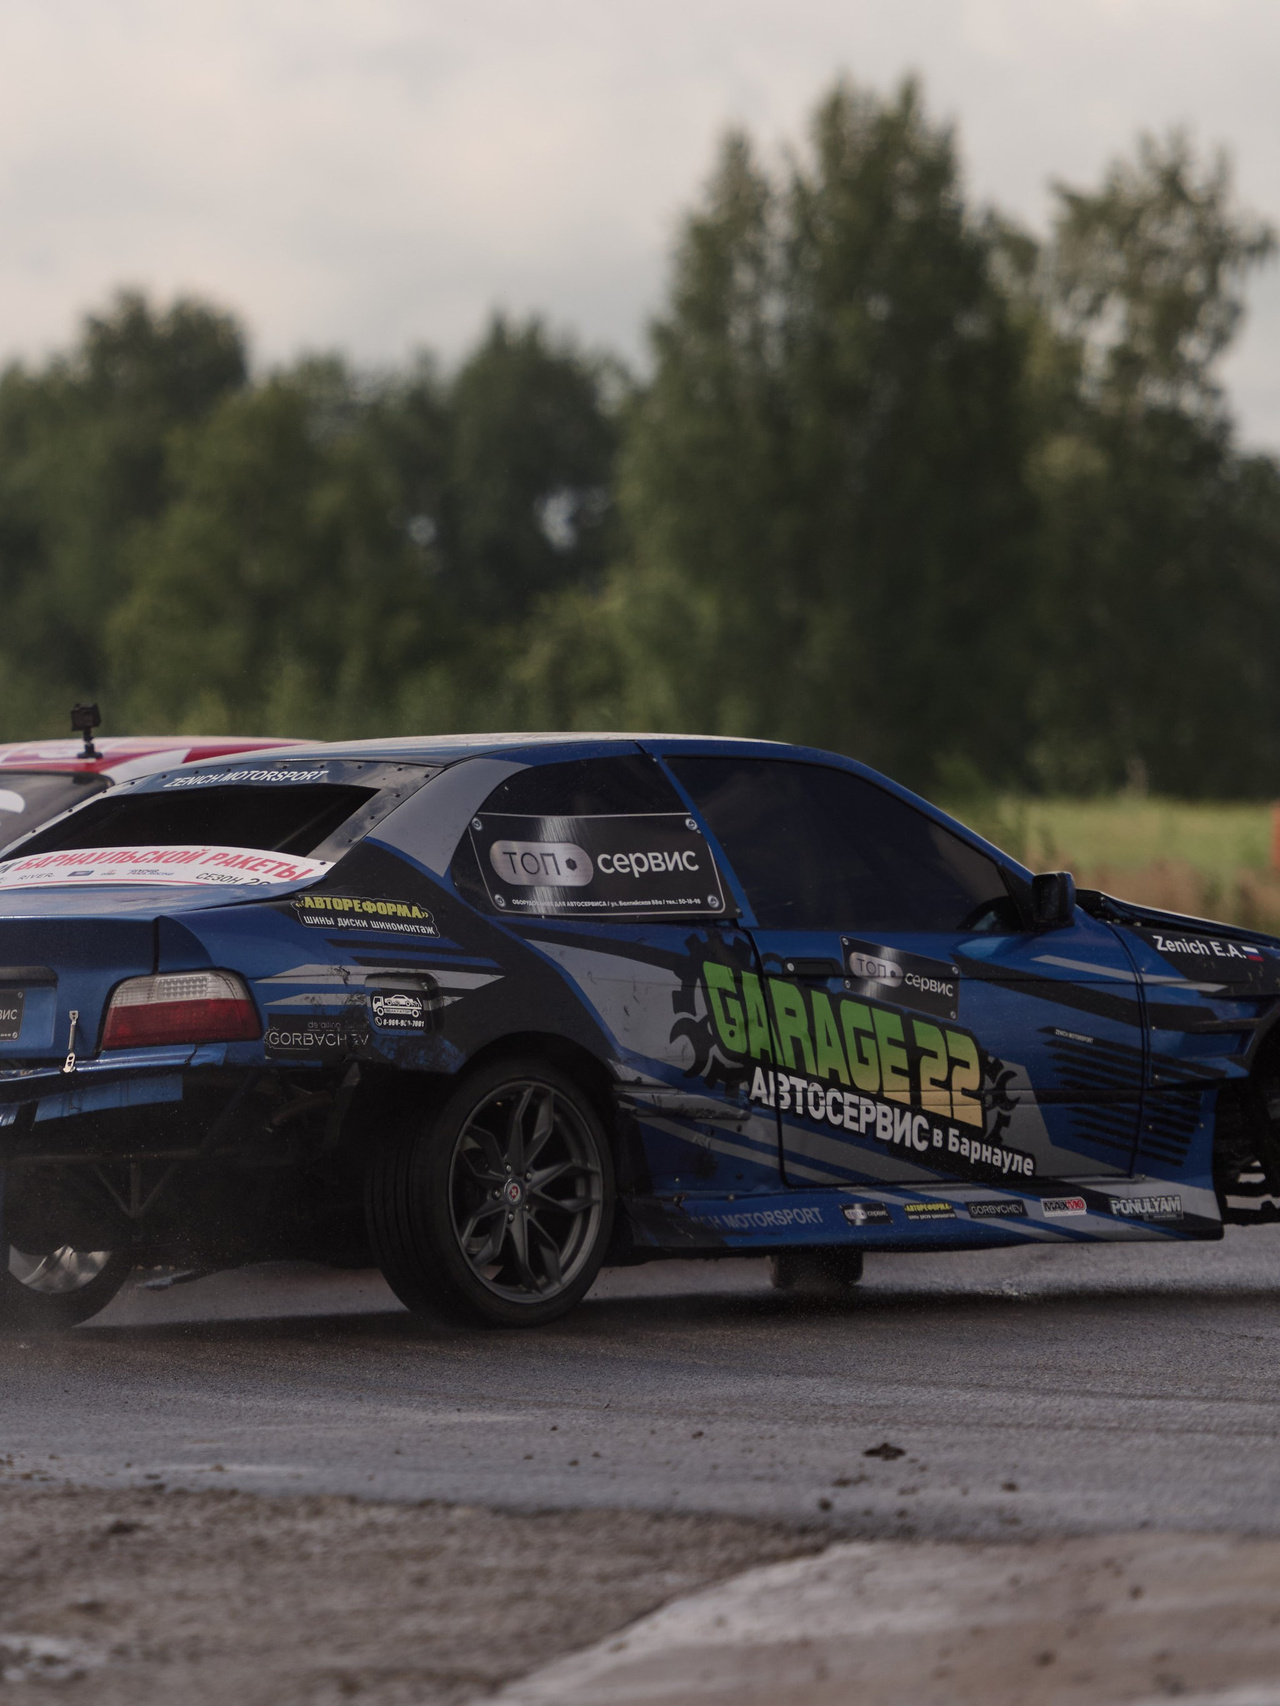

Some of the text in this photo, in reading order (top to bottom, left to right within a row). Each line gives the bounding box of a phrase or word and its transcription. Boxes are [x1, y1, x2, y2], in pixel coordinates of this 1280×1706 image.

[164, 770, 328, 788] ZENICH MOTORSPORT
[13, 848, 209, 871] БАРНАУЛЬСКОЙ
[200, 853, 314, 881] РАКЕТЫ
[502, 850, 699, 878] ТОП сервис
[196, 873, 243, 883] СЕЗОН
[304, 915, 335, 926] ШИНЫ
[338, 917, 368, 928] ДИСКИ
[1152, 935, 1247, 960] Zenich E.A.
[856, 956, 954, 997] ТОП сервис
[703, 960, 983, 1129] GARAGE 22
[749, 1066, 1035, 1176] АВТОСЕРВИС в Барнауле
[1110, 1196, 1181, 1214] PONULYAM
[722, 1207, 824, 1229] MOTORSPORT
